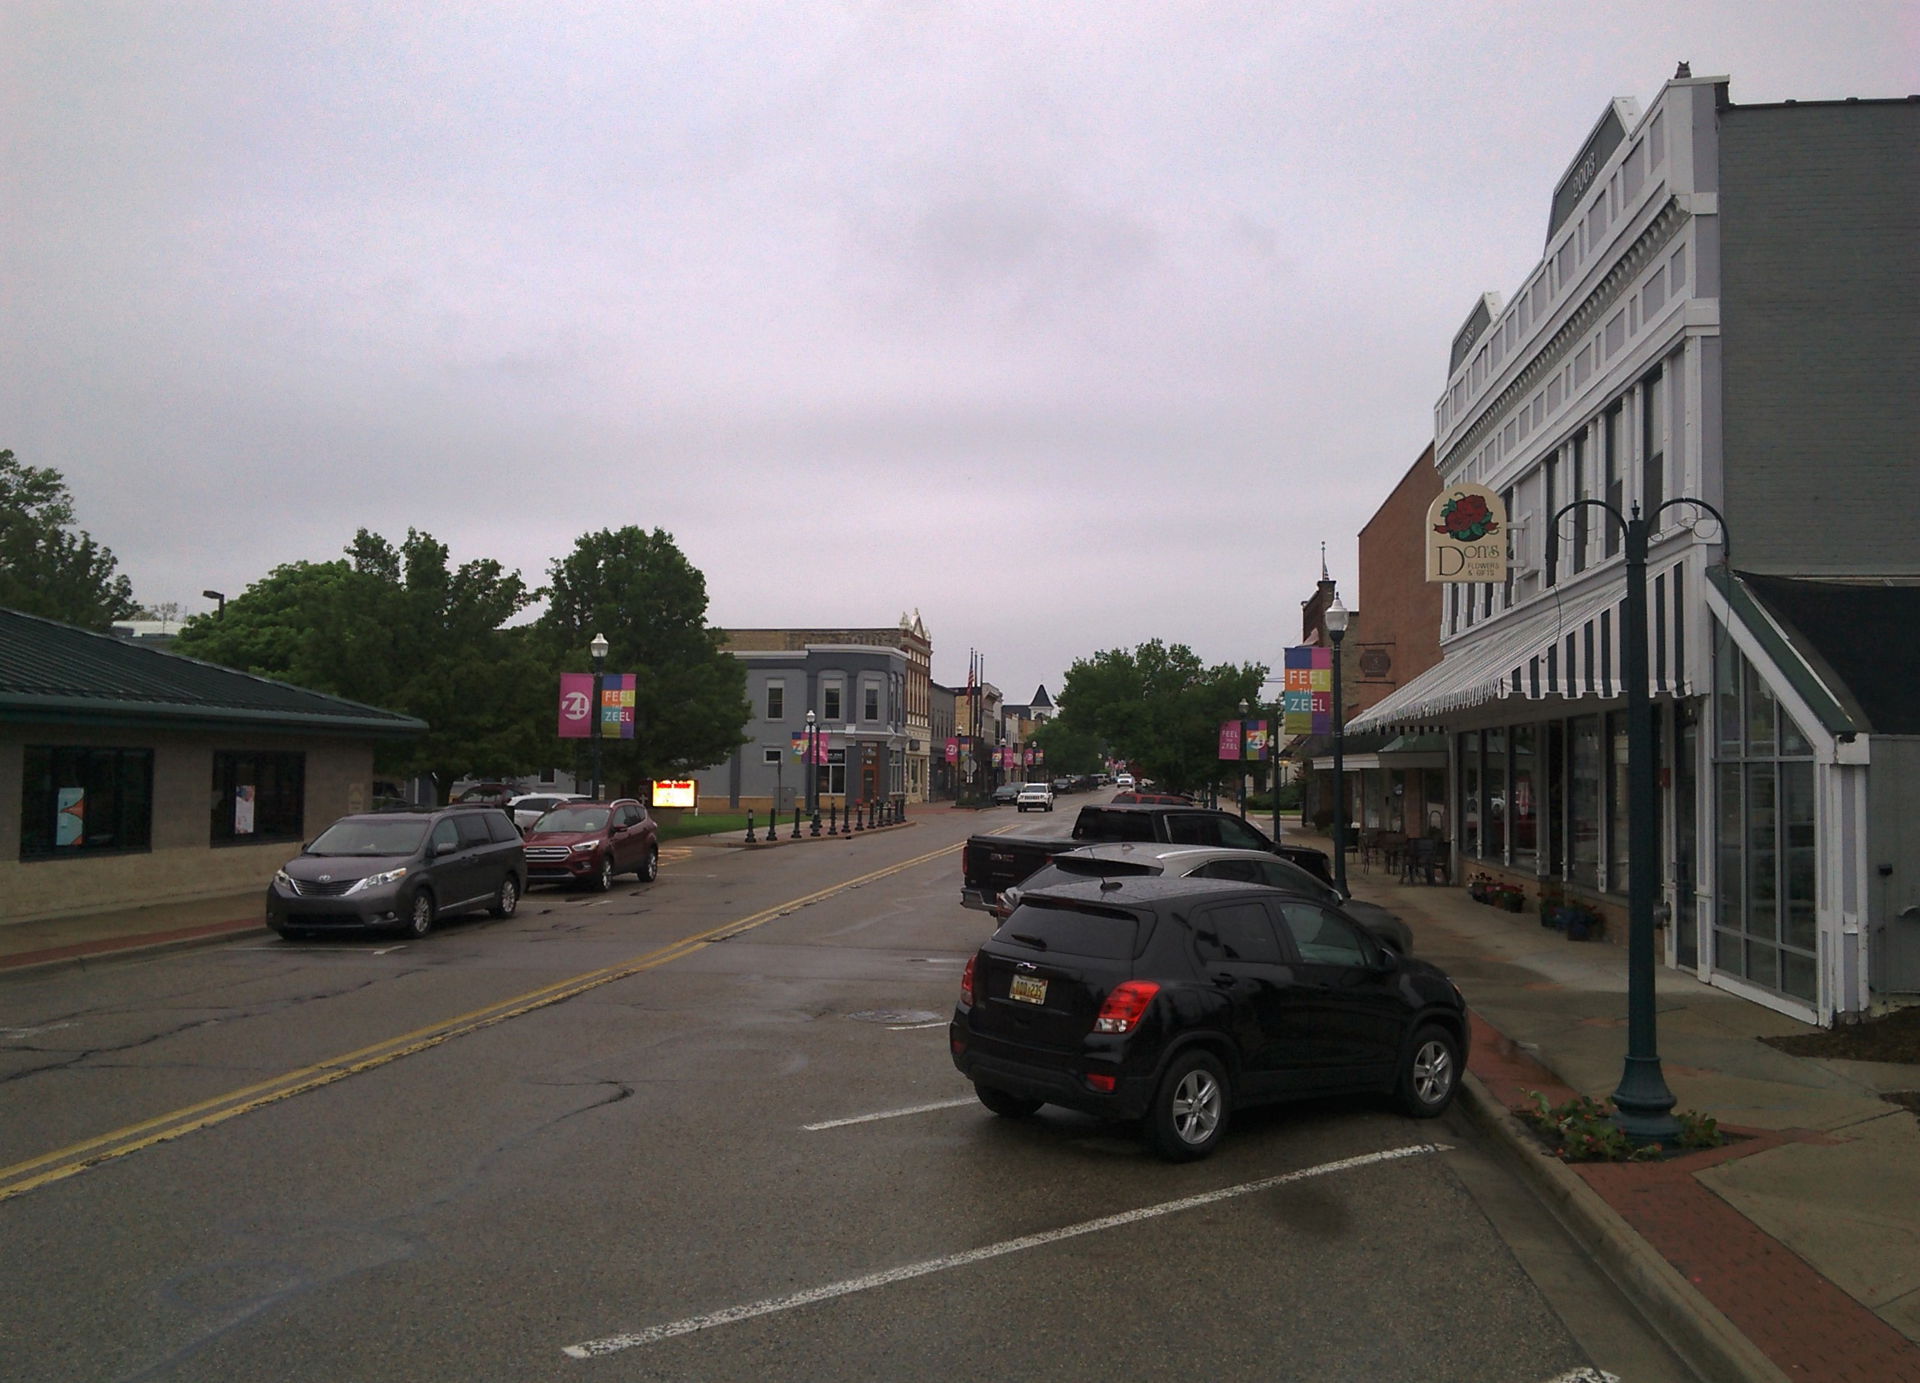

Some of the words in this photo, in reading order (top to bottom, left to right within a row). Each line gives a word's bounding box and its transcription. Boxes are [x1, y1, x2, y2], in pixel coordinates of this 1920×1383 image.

[1467, 562, 1500, 570] FLOWERS
[1289, 670, 1326, 685] FEEL
[605, 691, 633, 702] FEEL
[1299, 687, 1314, 696] THE
[1290, 698, 1326, 712] ZEEL
[605, 712, 631, 722] ZEEL
[1221, 730, 1238, 738] FEEL
